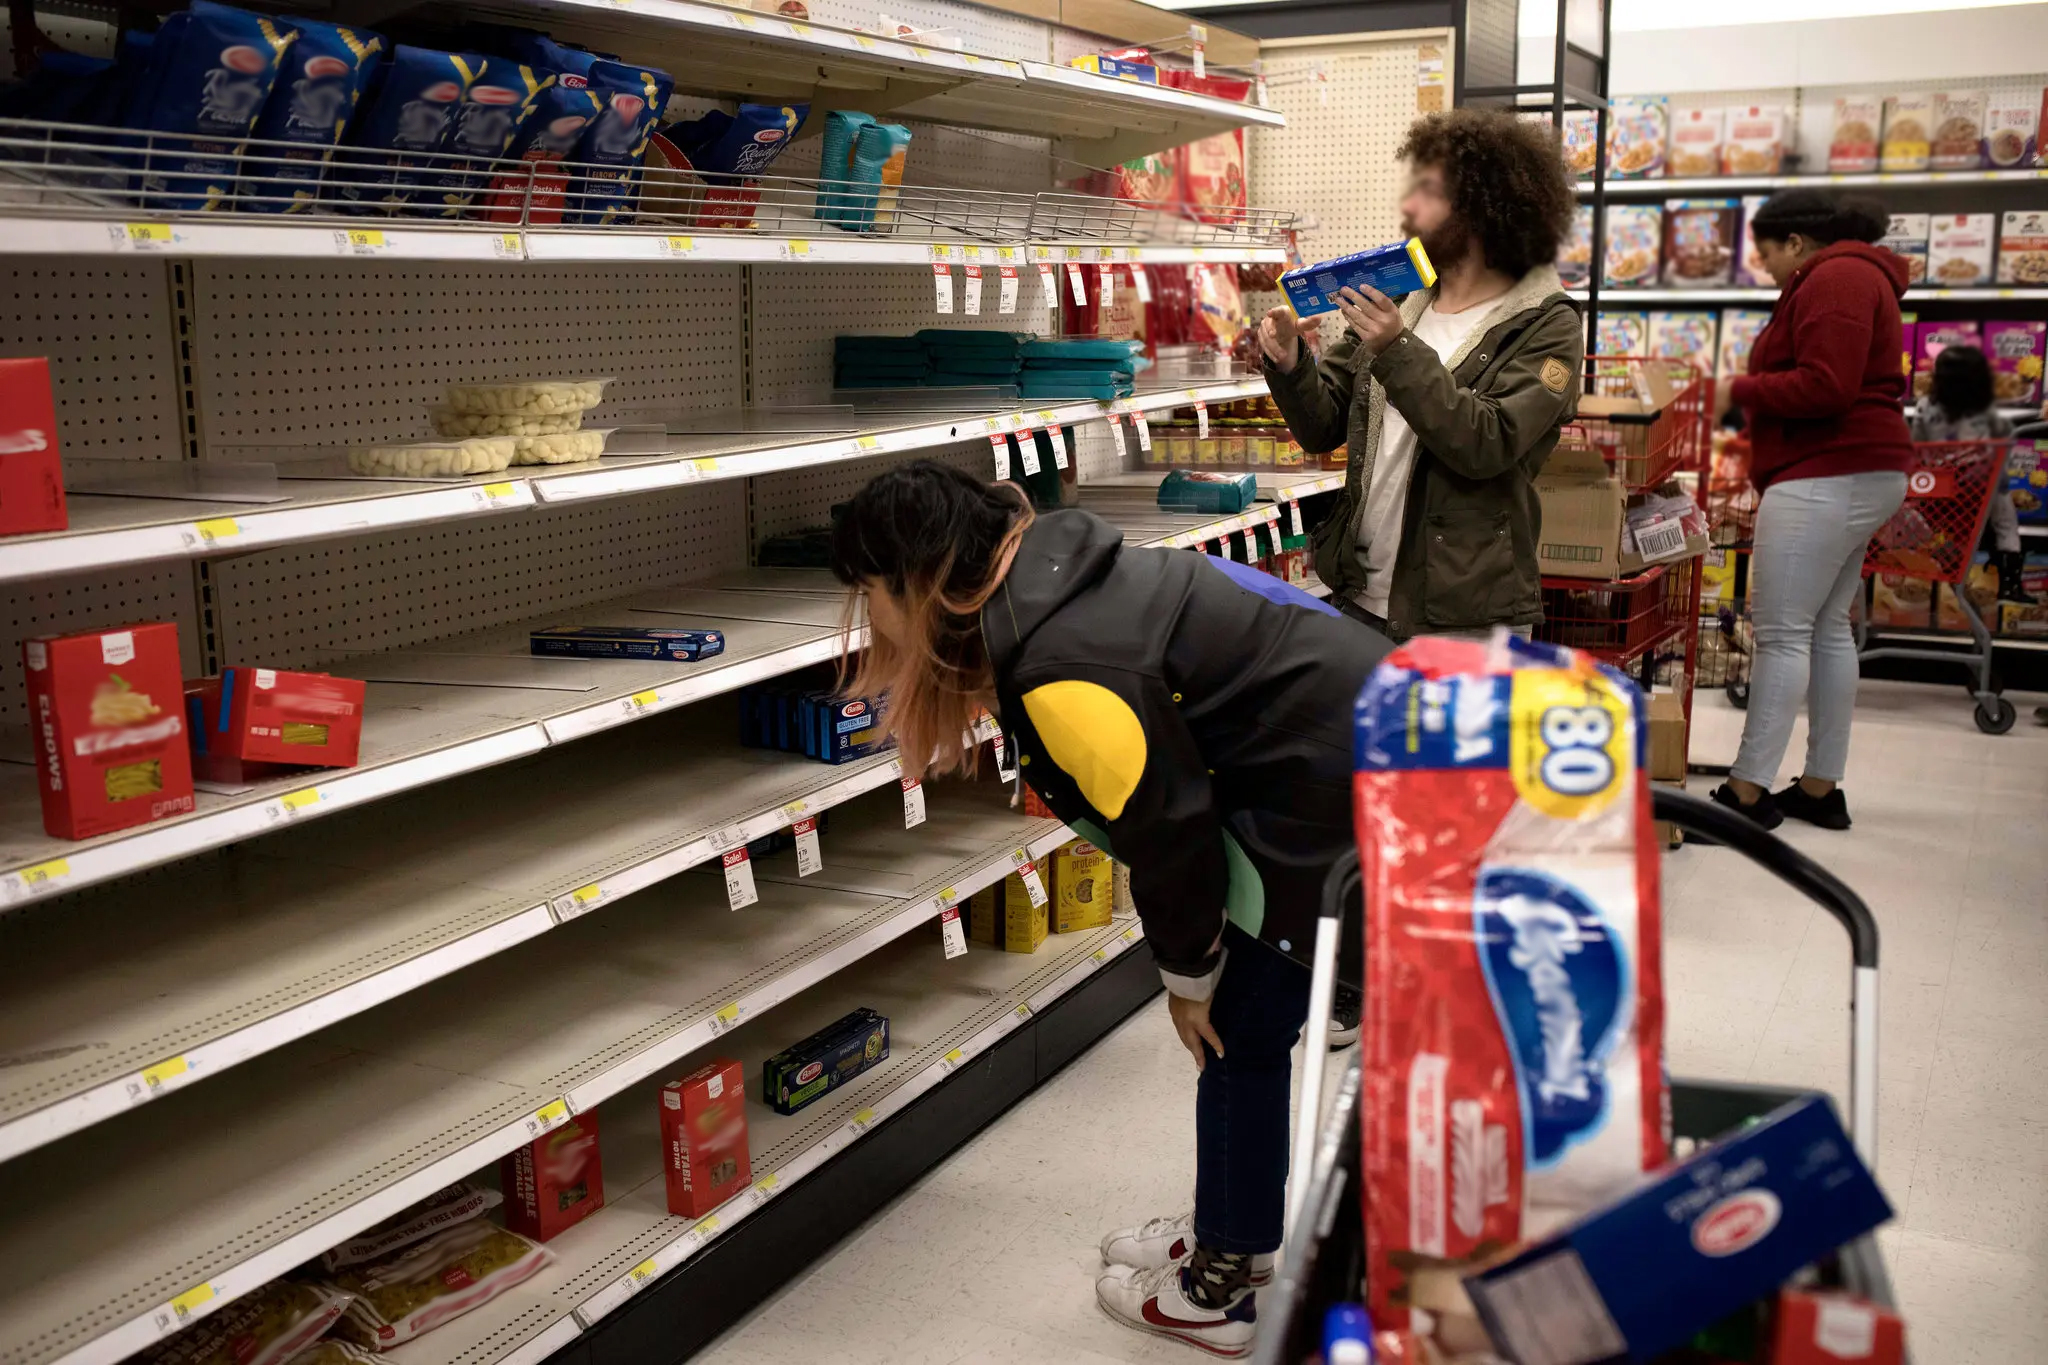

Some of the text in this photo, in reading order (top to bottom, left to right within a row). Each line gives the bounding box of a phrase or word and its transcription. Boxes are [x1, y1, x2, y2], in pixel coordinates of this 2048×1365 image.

[350, 234, 368, 245] 1.99
[858, 716, 870, 724] FREE
[39, 694, 62, 791] ELBOWS
[902, 777, 916, 790] Sale!
[794, 821, 810, 834] Sale!
[724, 851, 743, 866] Sale!
[942, 910, 955, 922] Sale!
[801, 1062, 822, 1080] Barilla
[673, 1140, 681, 1169] ROTINI
